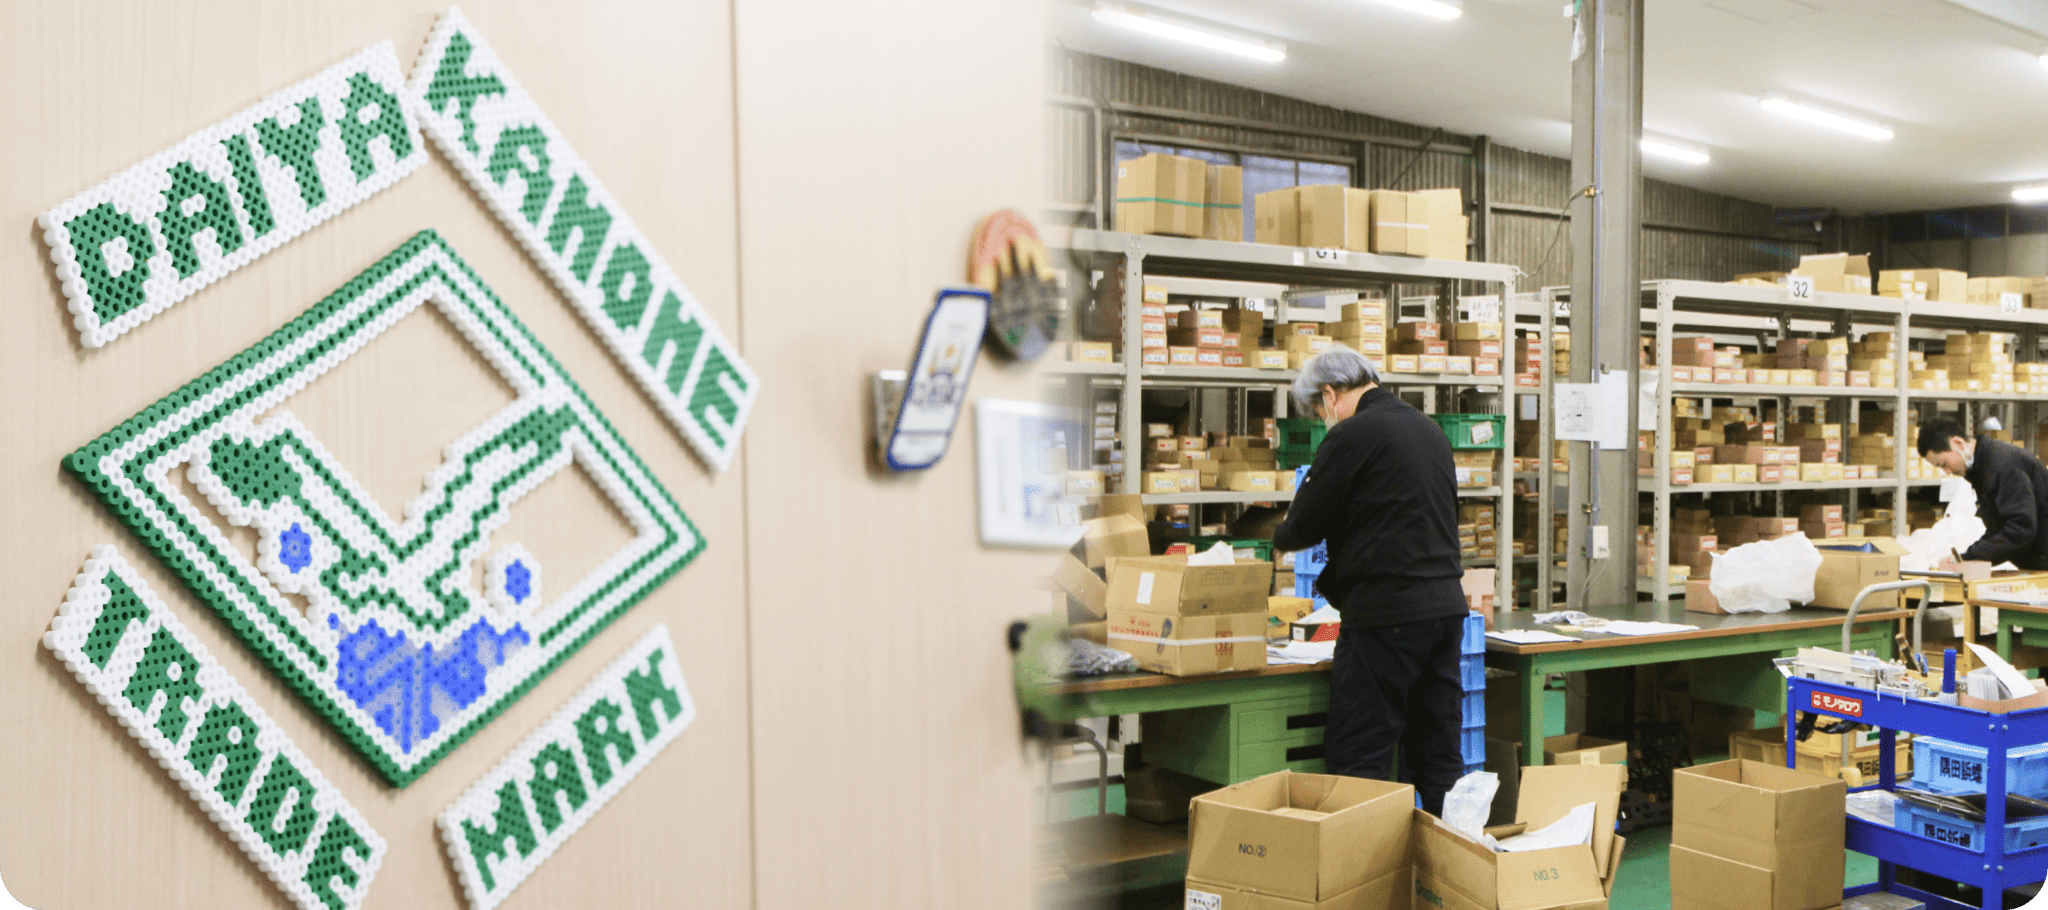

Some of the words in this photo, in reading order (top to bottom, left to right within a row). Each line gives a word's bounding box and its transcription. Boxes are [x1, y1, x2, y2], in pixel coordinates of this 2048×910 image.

[64, 72, 413, 325] DAIYA
[424, 31, 747, 451] KANONE
[1793, 280, 1808, 299] 32
[2004, 296, 2017, 313] 33
[81, 571, 372, 910] TRADE
[460, 648, 682, 893] MARK
[1823, 695, 1861, 714] モノタロウ
